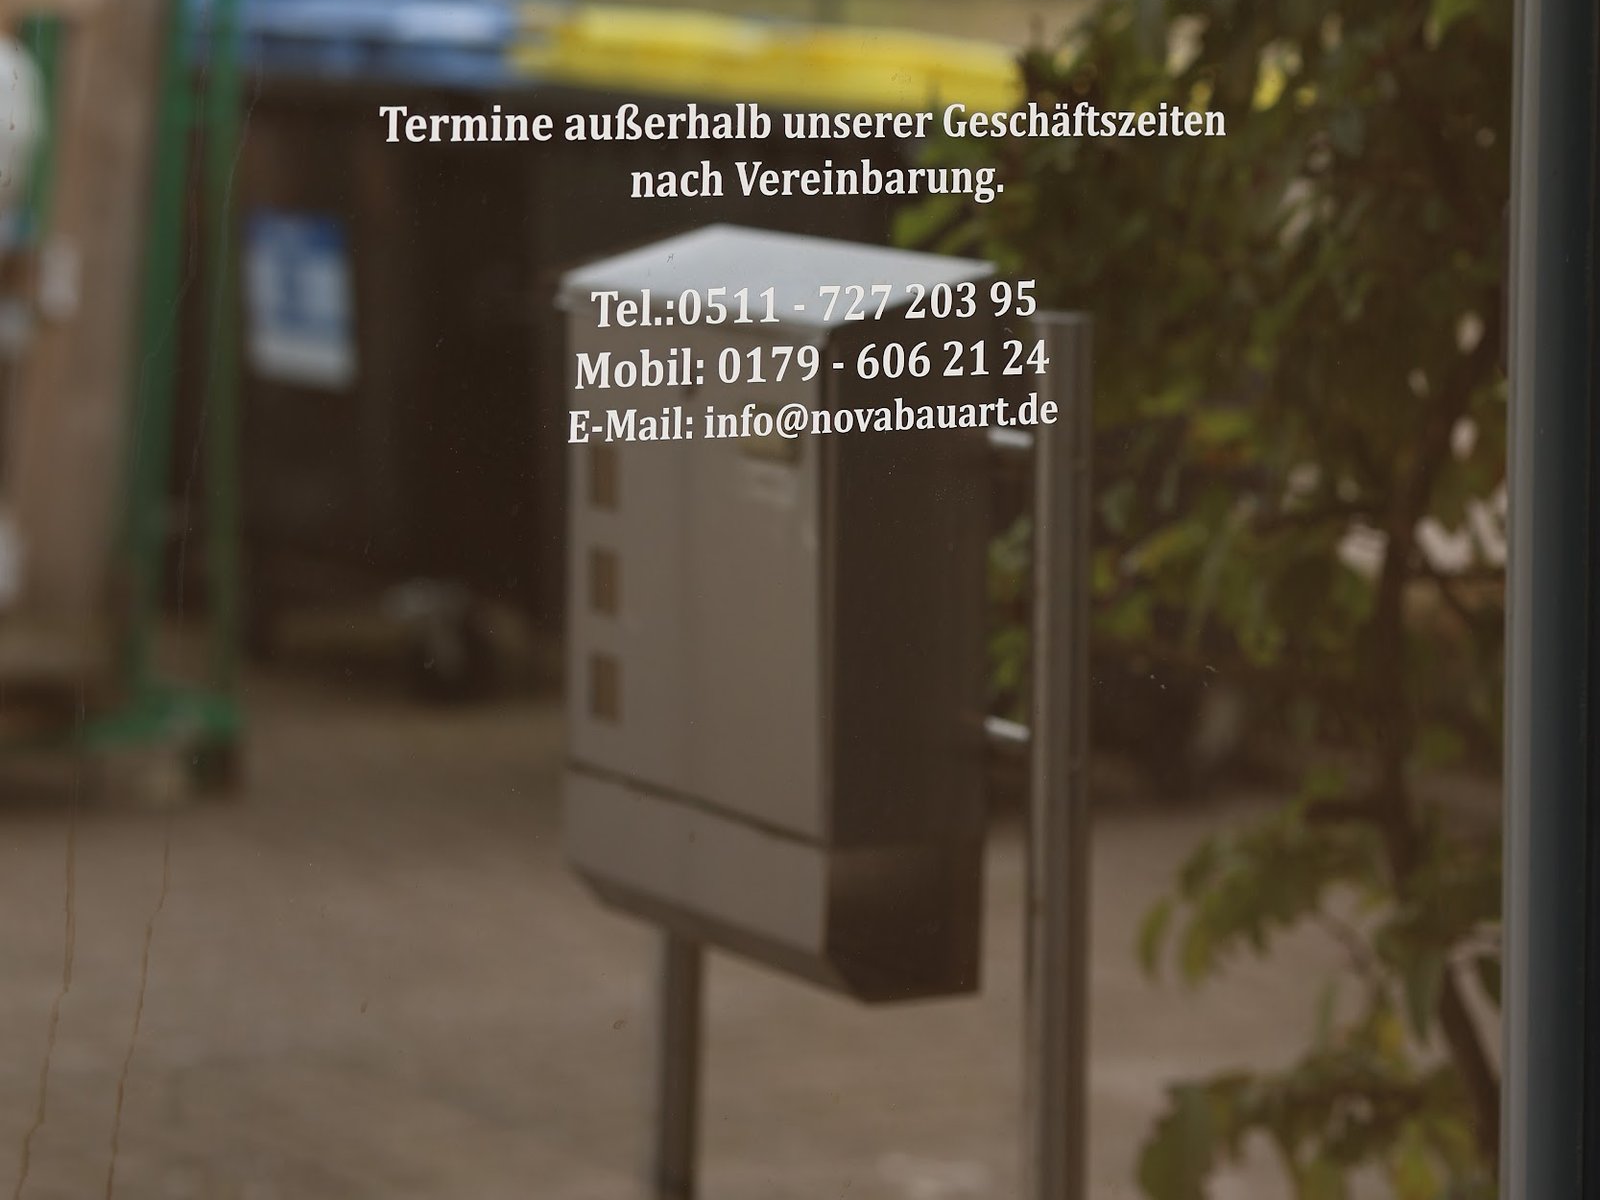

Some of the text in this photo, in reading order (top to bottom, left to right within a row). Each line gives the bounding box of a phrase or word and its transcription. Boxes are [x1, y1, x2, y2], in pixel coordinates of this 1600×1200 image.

[379, 102, 1226, 142] Termine außerhalb unserer Geschäftszeiten
[631, 159, 1003, 203] nach Vereinbarung.
[819, 285, 892, 323] 727
[904, 283, 977, 320] 203
[990, 280, 1038, 318] 95
[575, 340, 1049, 389] Mobil: 0179 - 606 21 24
[568, 393, 1058, 443] E-Mail: info@novabauart.de
